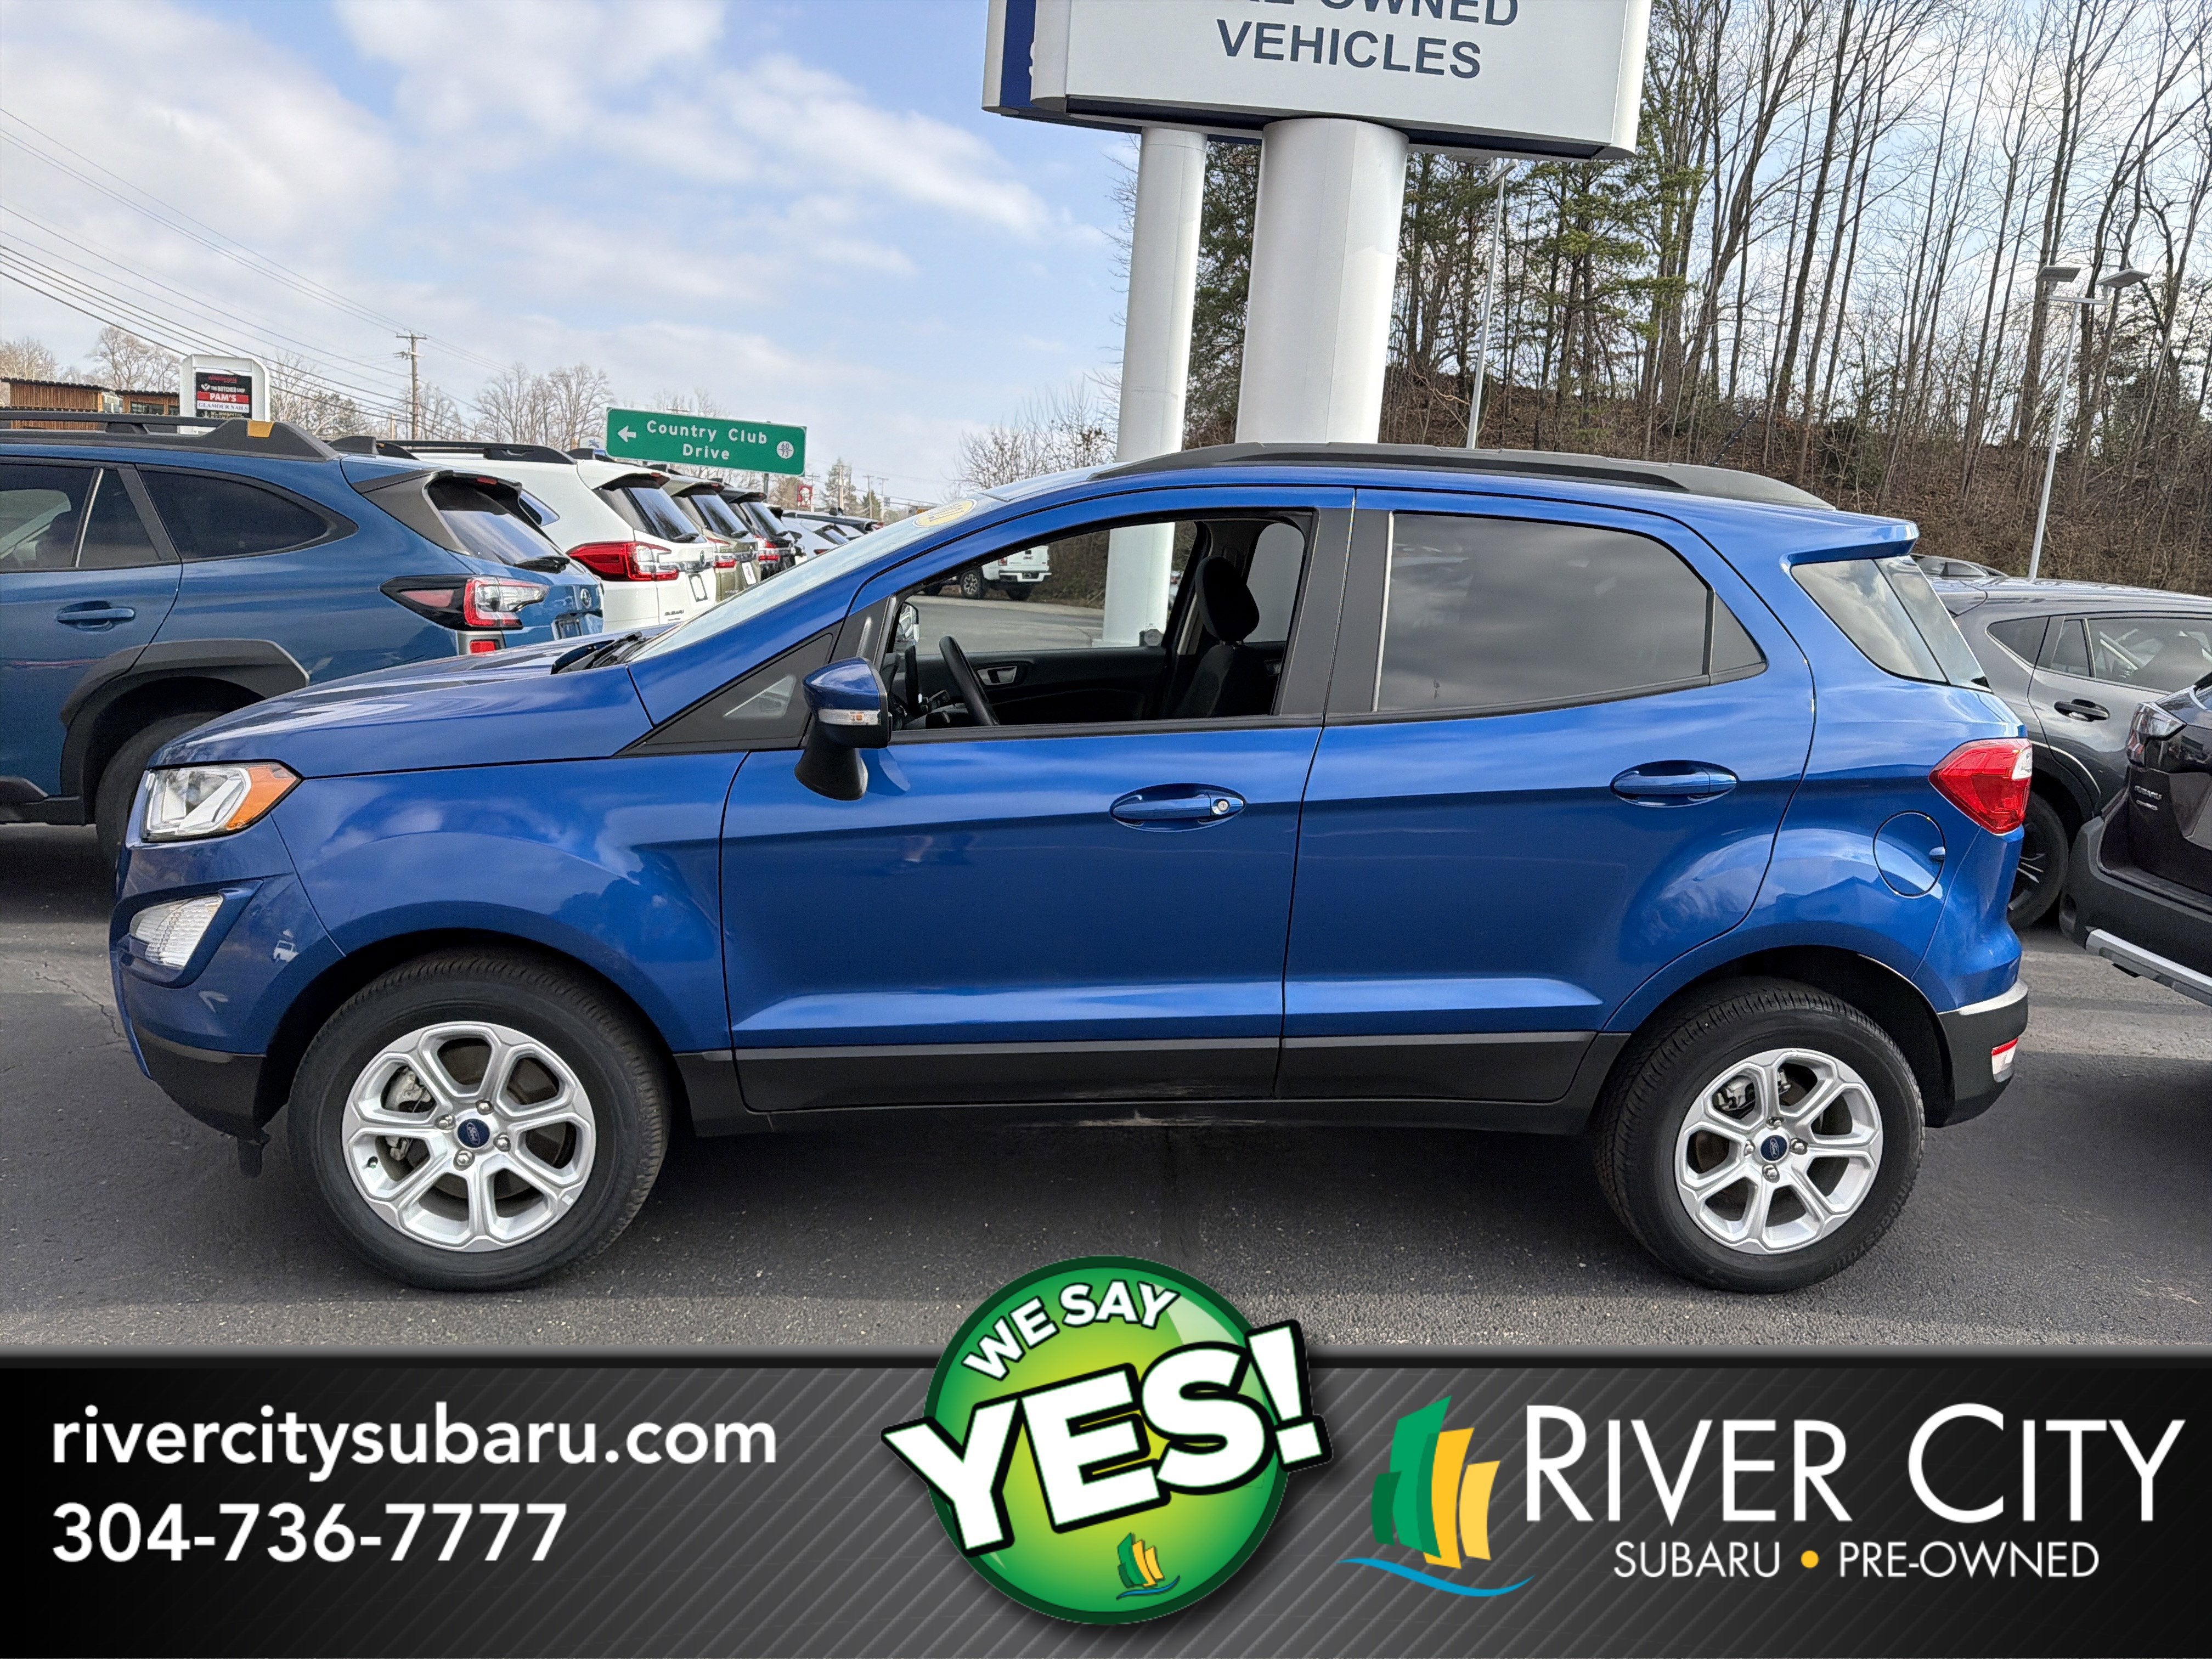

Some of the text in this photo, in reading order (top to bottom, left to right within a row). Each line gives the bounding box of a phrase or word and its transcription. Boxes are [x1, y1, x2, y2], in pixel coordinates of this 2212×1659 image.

[1216, 19, 1481, 80] VEHICLES
[210, 392, 236, 402] PAM'S
[646, 420, 767, 444] Country Club
[682, 443, 730, 460] Drive
